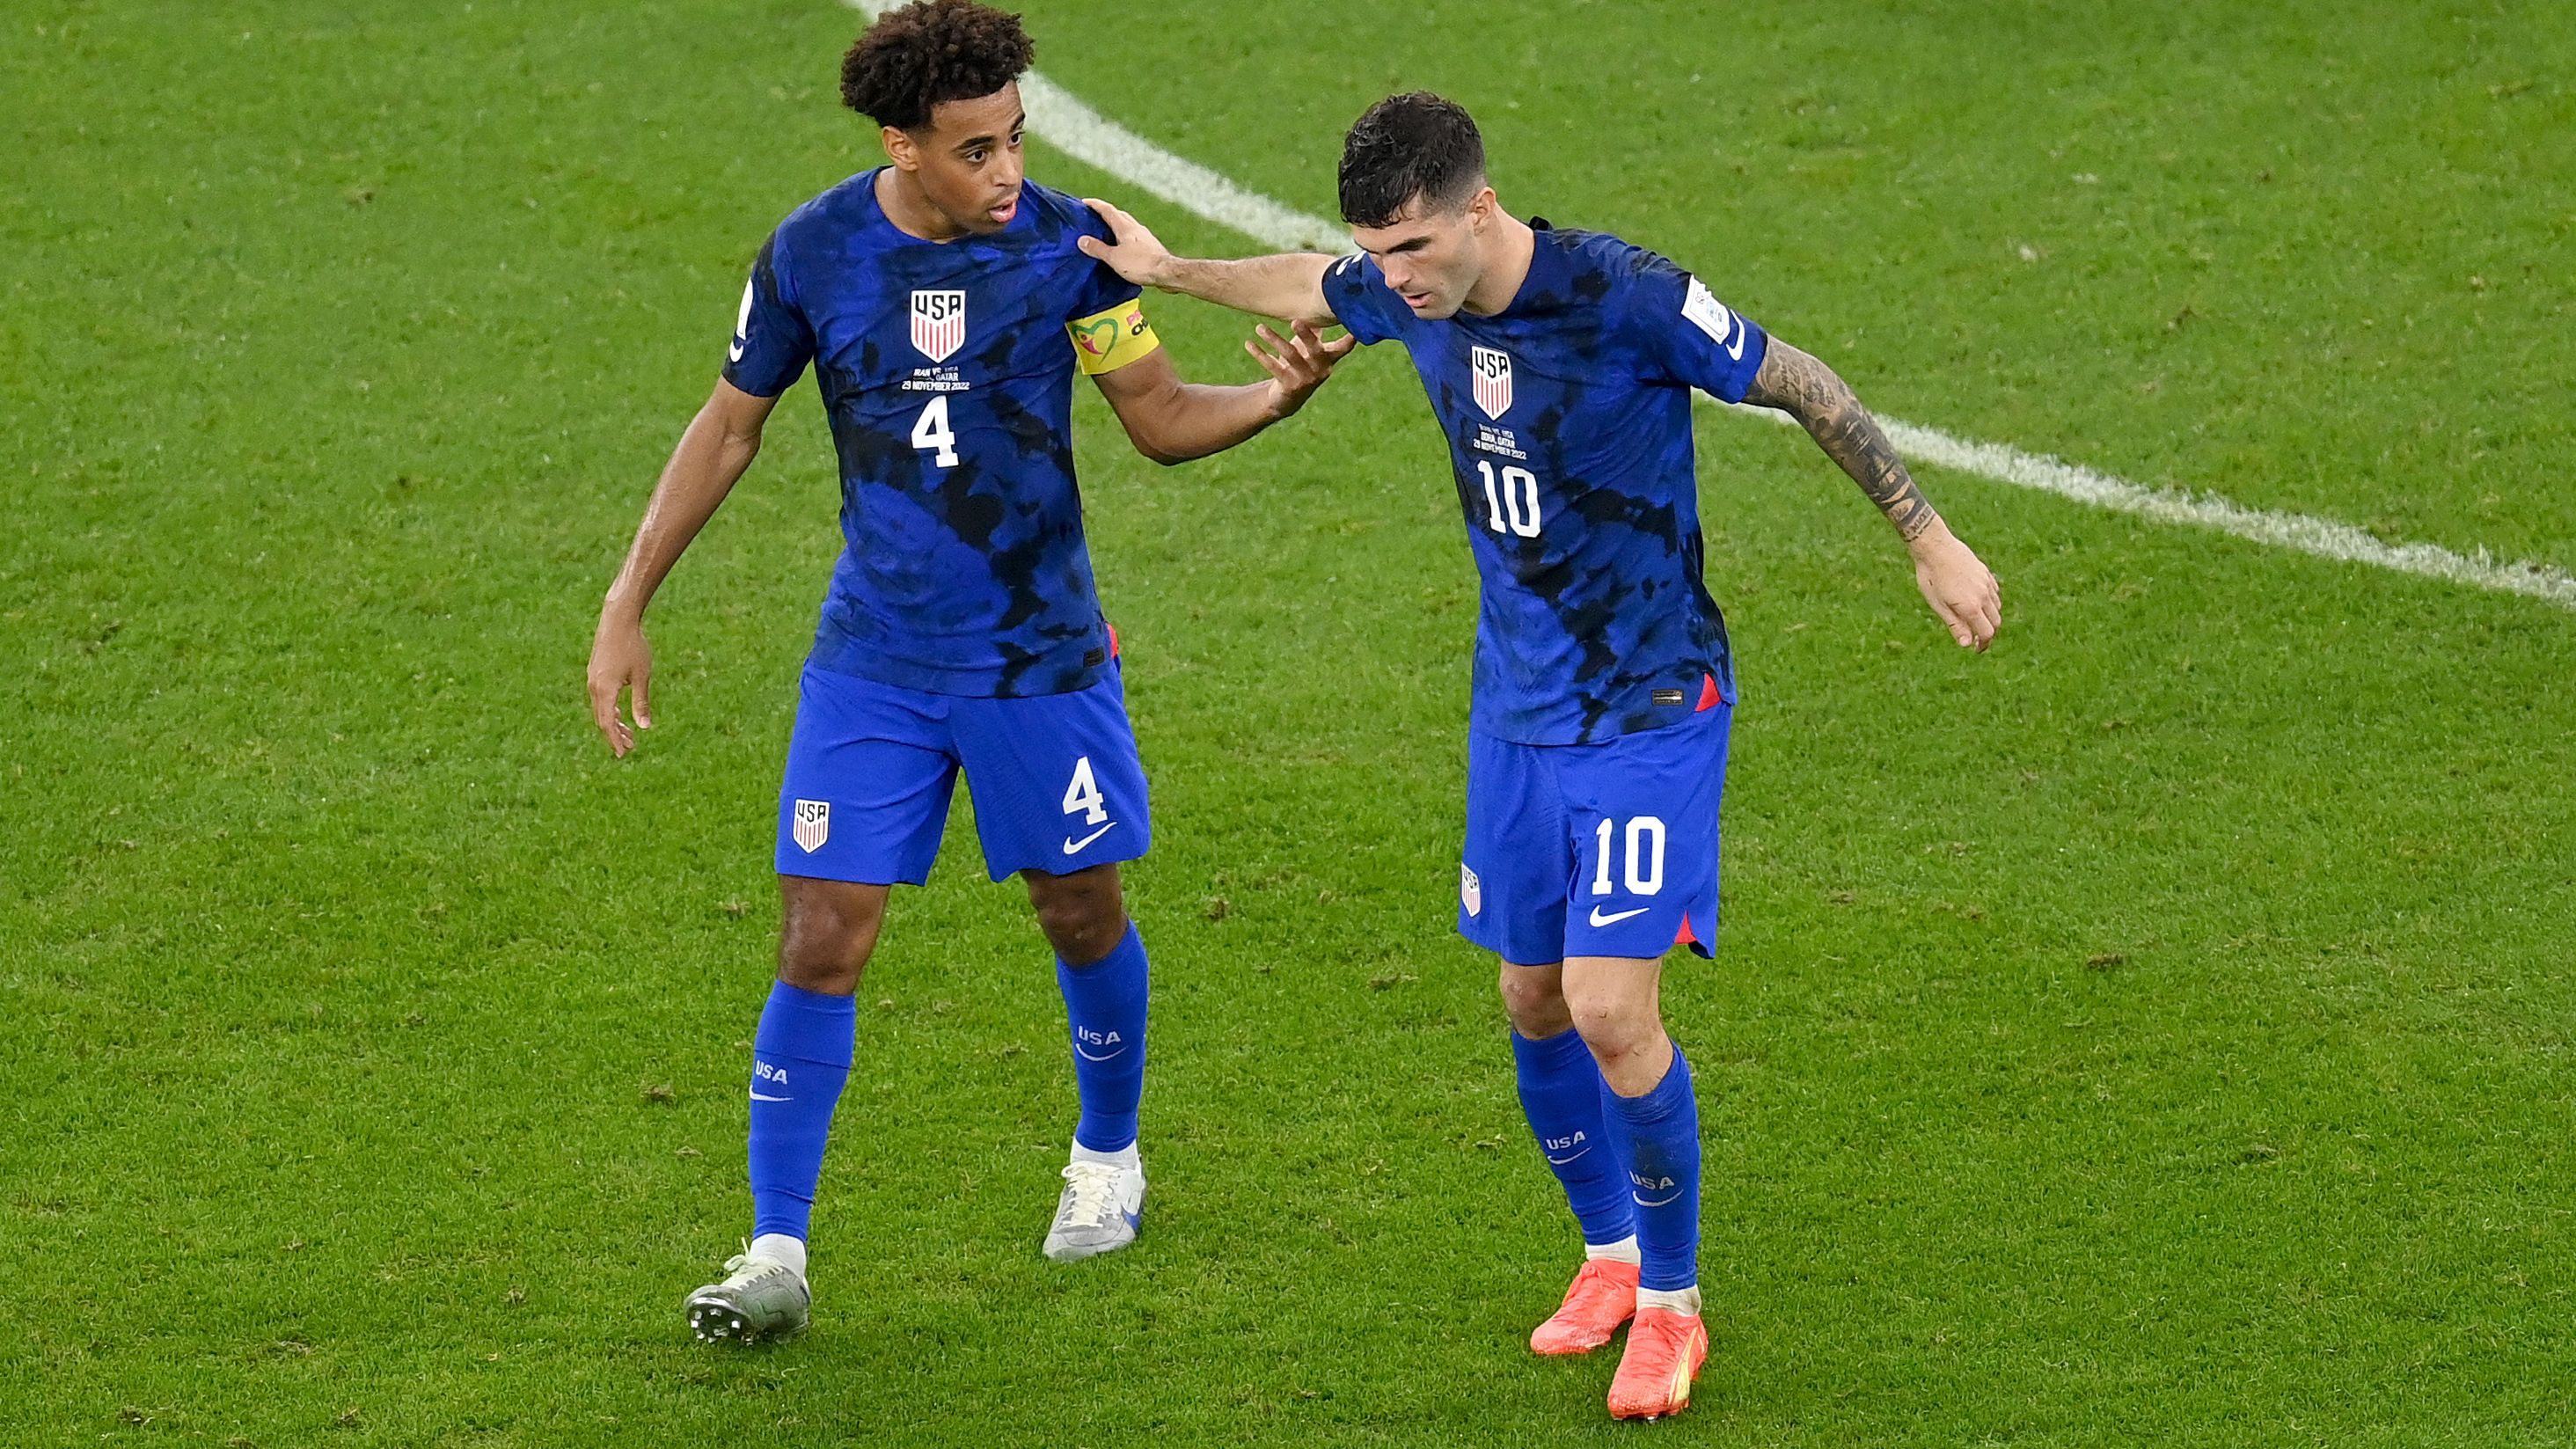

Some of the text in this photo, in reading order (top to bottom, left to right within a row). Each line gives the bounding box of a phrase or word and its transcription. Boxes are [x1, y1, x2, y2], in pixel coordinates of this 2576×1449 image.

[915, 295, 961, 321] USA
[935, 372, 959, 381] QATAR
[1475, 350, 1508, 379] USA
[901, 380, 970, 391] 29 NOVEMBER 2022
[911, 395, 959, 468] 4
[1477, 459, 1541, 538] 10
[1062, 756, 1108, 825] 4
[797, 802, 826, 823] USA
[1592, 816, 1665, 896] 10
[1078, 1025, 1121, 1045] USA
[756, 1059, 787, 1085] USA
[1546, 1131, 1586, 1150] USA
[1628, 1167, 1675, 1190] USA
